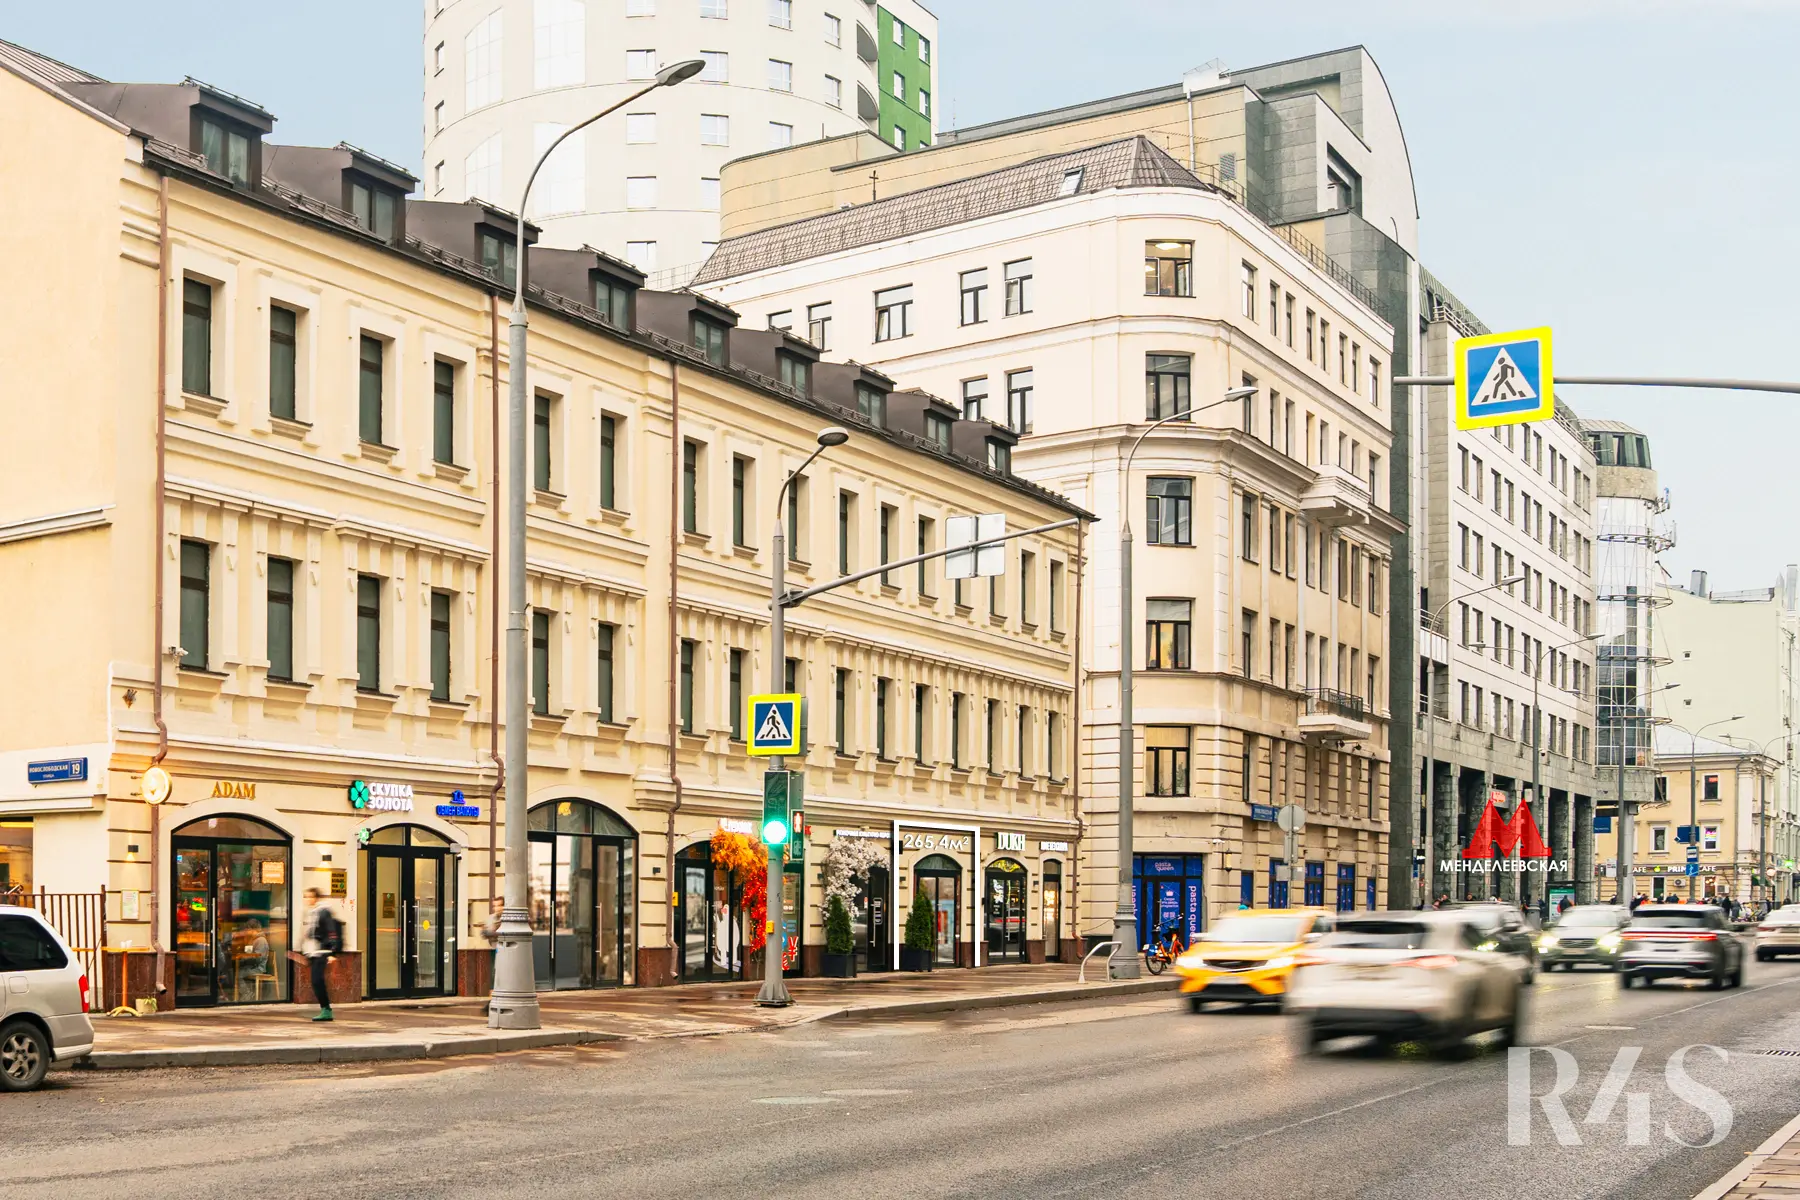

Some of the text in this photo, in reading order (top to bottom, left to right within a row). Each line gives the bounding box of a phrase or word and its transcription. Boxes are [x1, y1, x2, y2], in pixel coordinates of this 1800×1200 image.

[72, 763, 80, 774] 19
[211, 781, 256, 801] ADAM
[369, 783, 413, 797] СКУПКА
[368, 796, 413, 811] ЗОЛОТА
[997, 832, 1026, 851] DUKH
[1188, 885, 1197, 913] pasta
